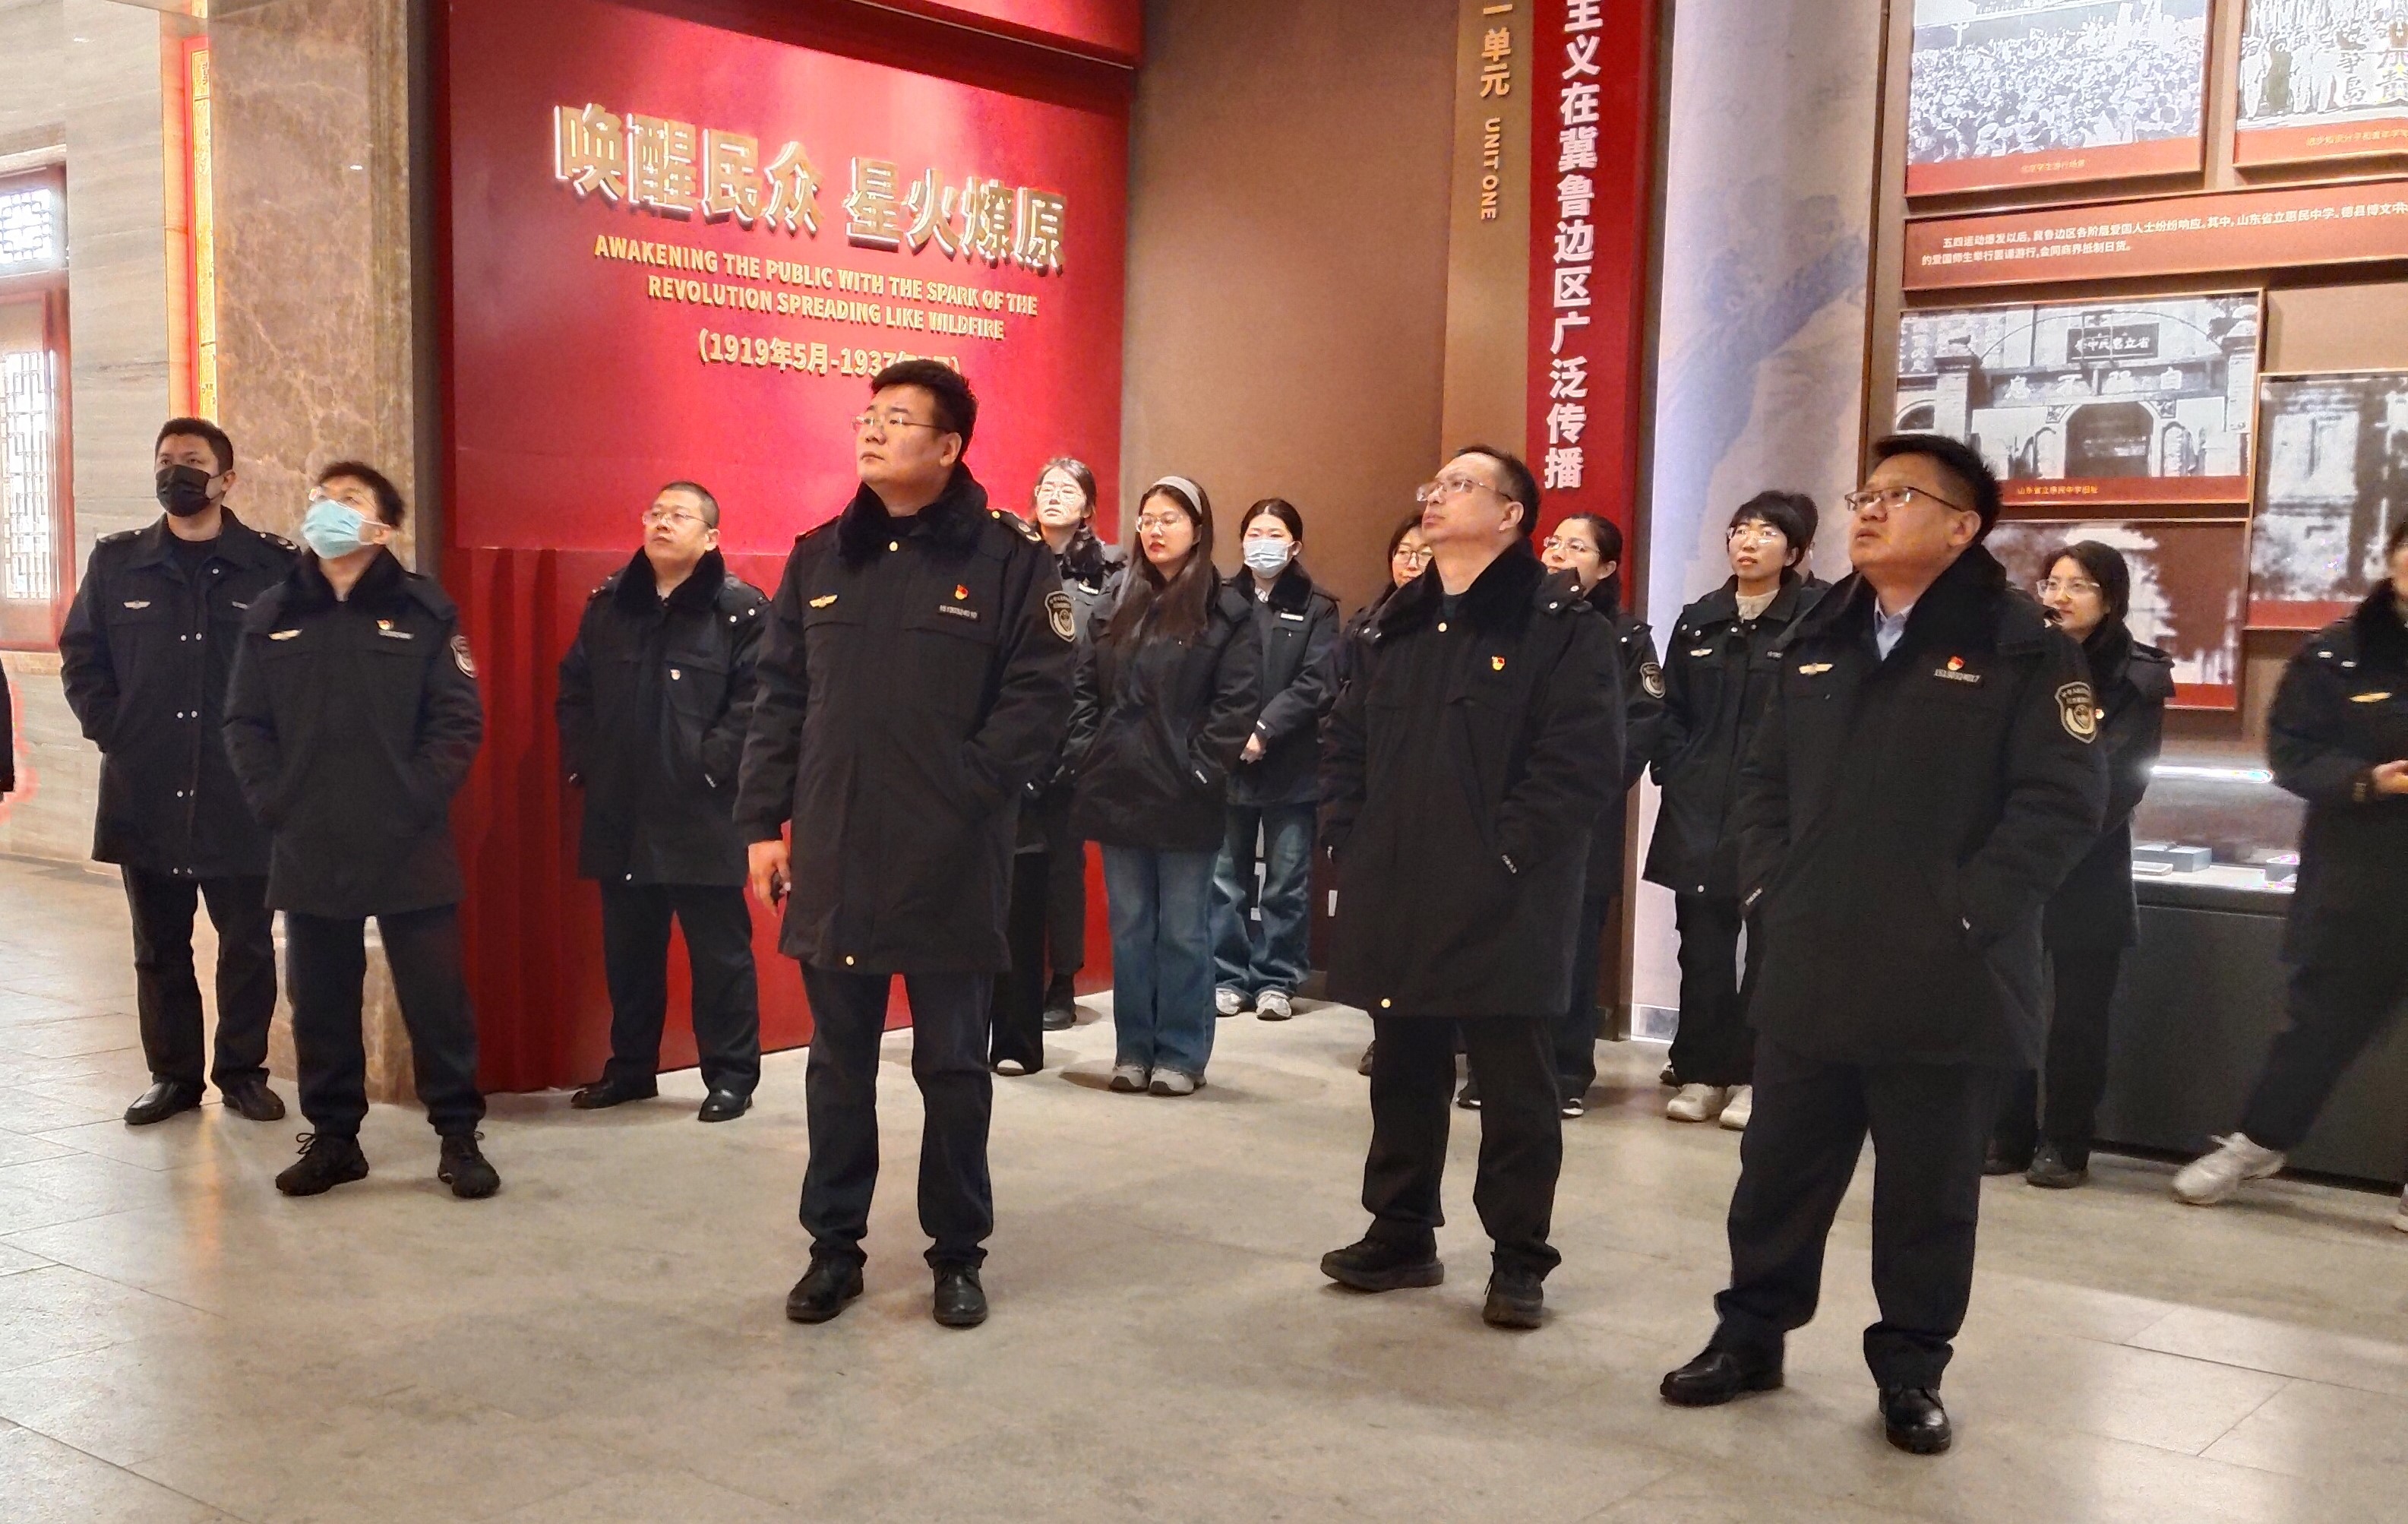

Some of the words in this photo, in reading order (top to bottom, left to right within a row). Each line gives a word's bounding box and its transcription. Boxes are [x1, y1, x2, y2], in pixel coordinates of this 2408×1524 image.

[1481, 4, 1513, 98] 一单元
[1484, 116, 1501, 169] UNIT
[554, 103, 825, 235] 唤醒民众
[843, 157, 1065, 276] 星火燎原
[1481, 175, 1499, 220] ONE
[595, 235, 718, 273] AWAKENING
[722, 252, 760, 279] THE
[766, 259, 833, 289] PUBLIC
[837, 269, 884, 296] WITH
[888, 276, 923, 300] THE
[926, 281, 980, 308] SPARK
[982, 289, 1003, 311] OF
[1006, 292, 1038, 316] THE
[1544, 0, 1604, 489] 主义在冀鲁边区广泛传播
[648, 275, 773, 312] REVOLUTION
[776, 292, 881, 325] SPREADING
[886, 305, 924, 330] LIKE
[928, 311, 1004, 340] WILDFIRE
[698, 327, 960, 378] (1919年5月-1937)
